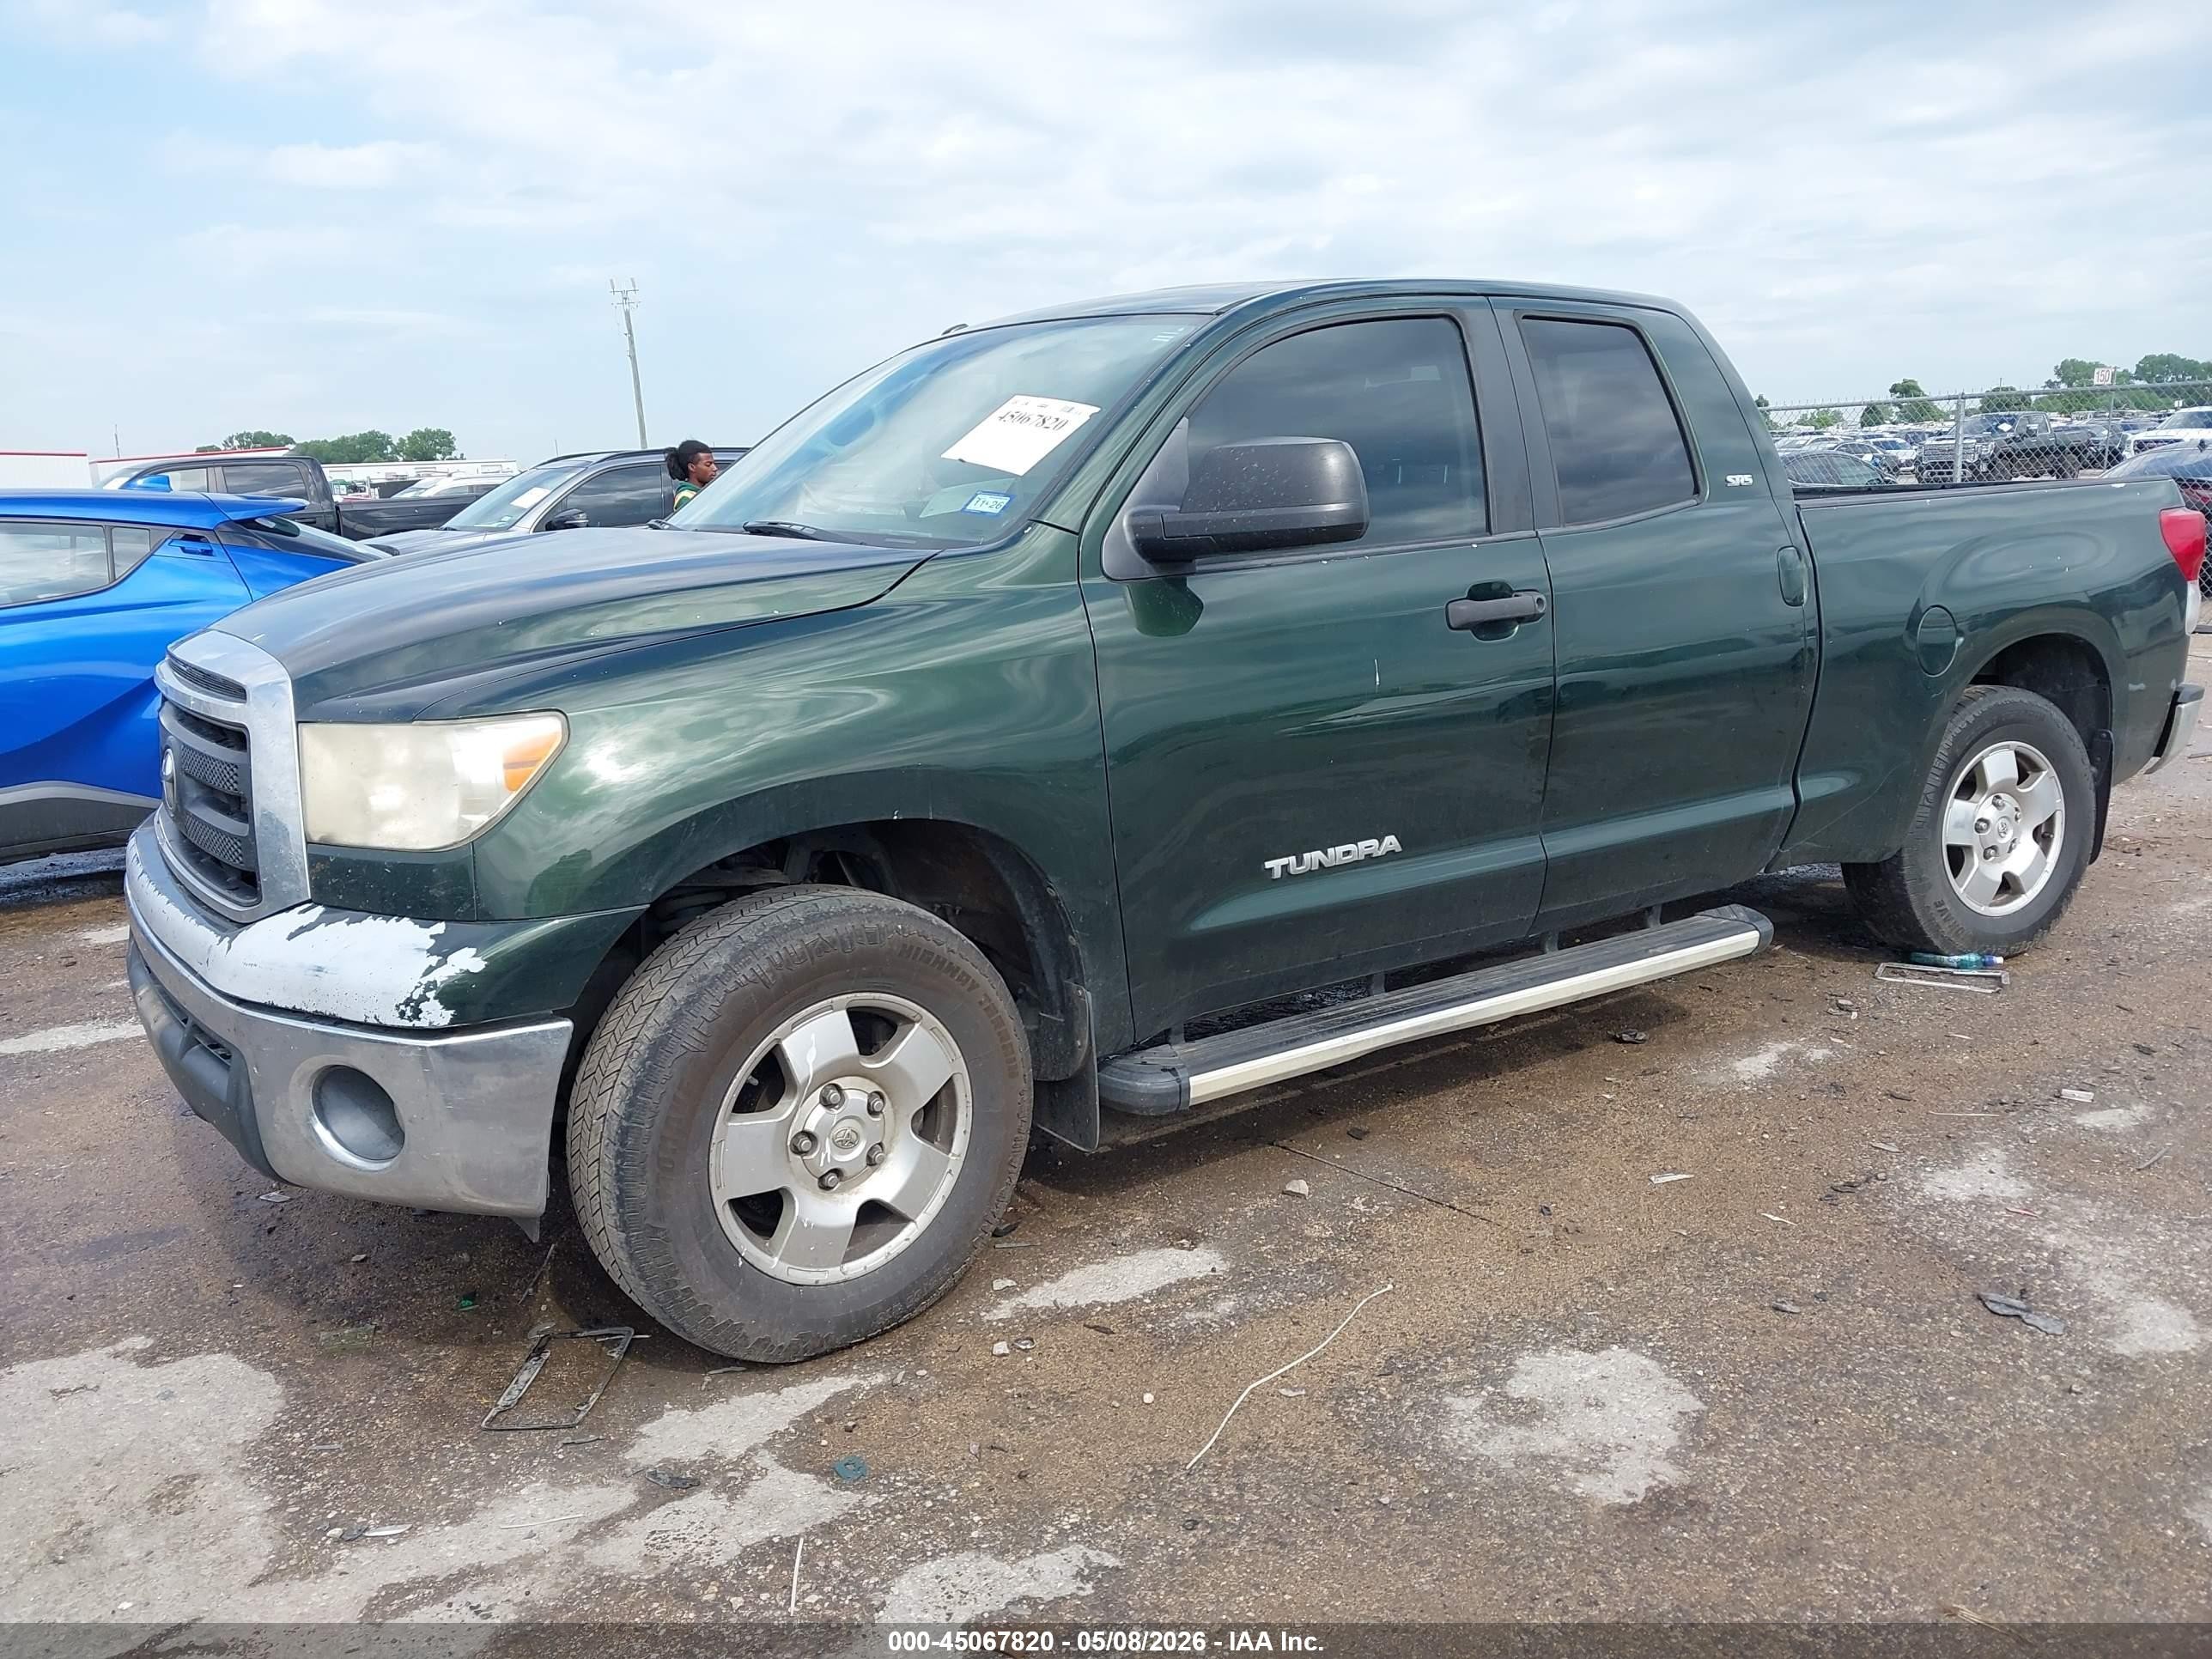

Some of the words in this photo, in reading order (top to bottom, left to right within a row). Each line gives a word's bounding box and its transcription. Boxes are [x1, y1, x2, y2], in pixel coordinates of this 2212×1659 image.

[2095, 369, 2111, 383] 150
[999, 410, 1069, 431] 45067820
[1725, 474, 1753, 487] SR5
[1263, 834, 1403, 879] TUNDRA
[896, 943, 981, 994] HIGHWAY
